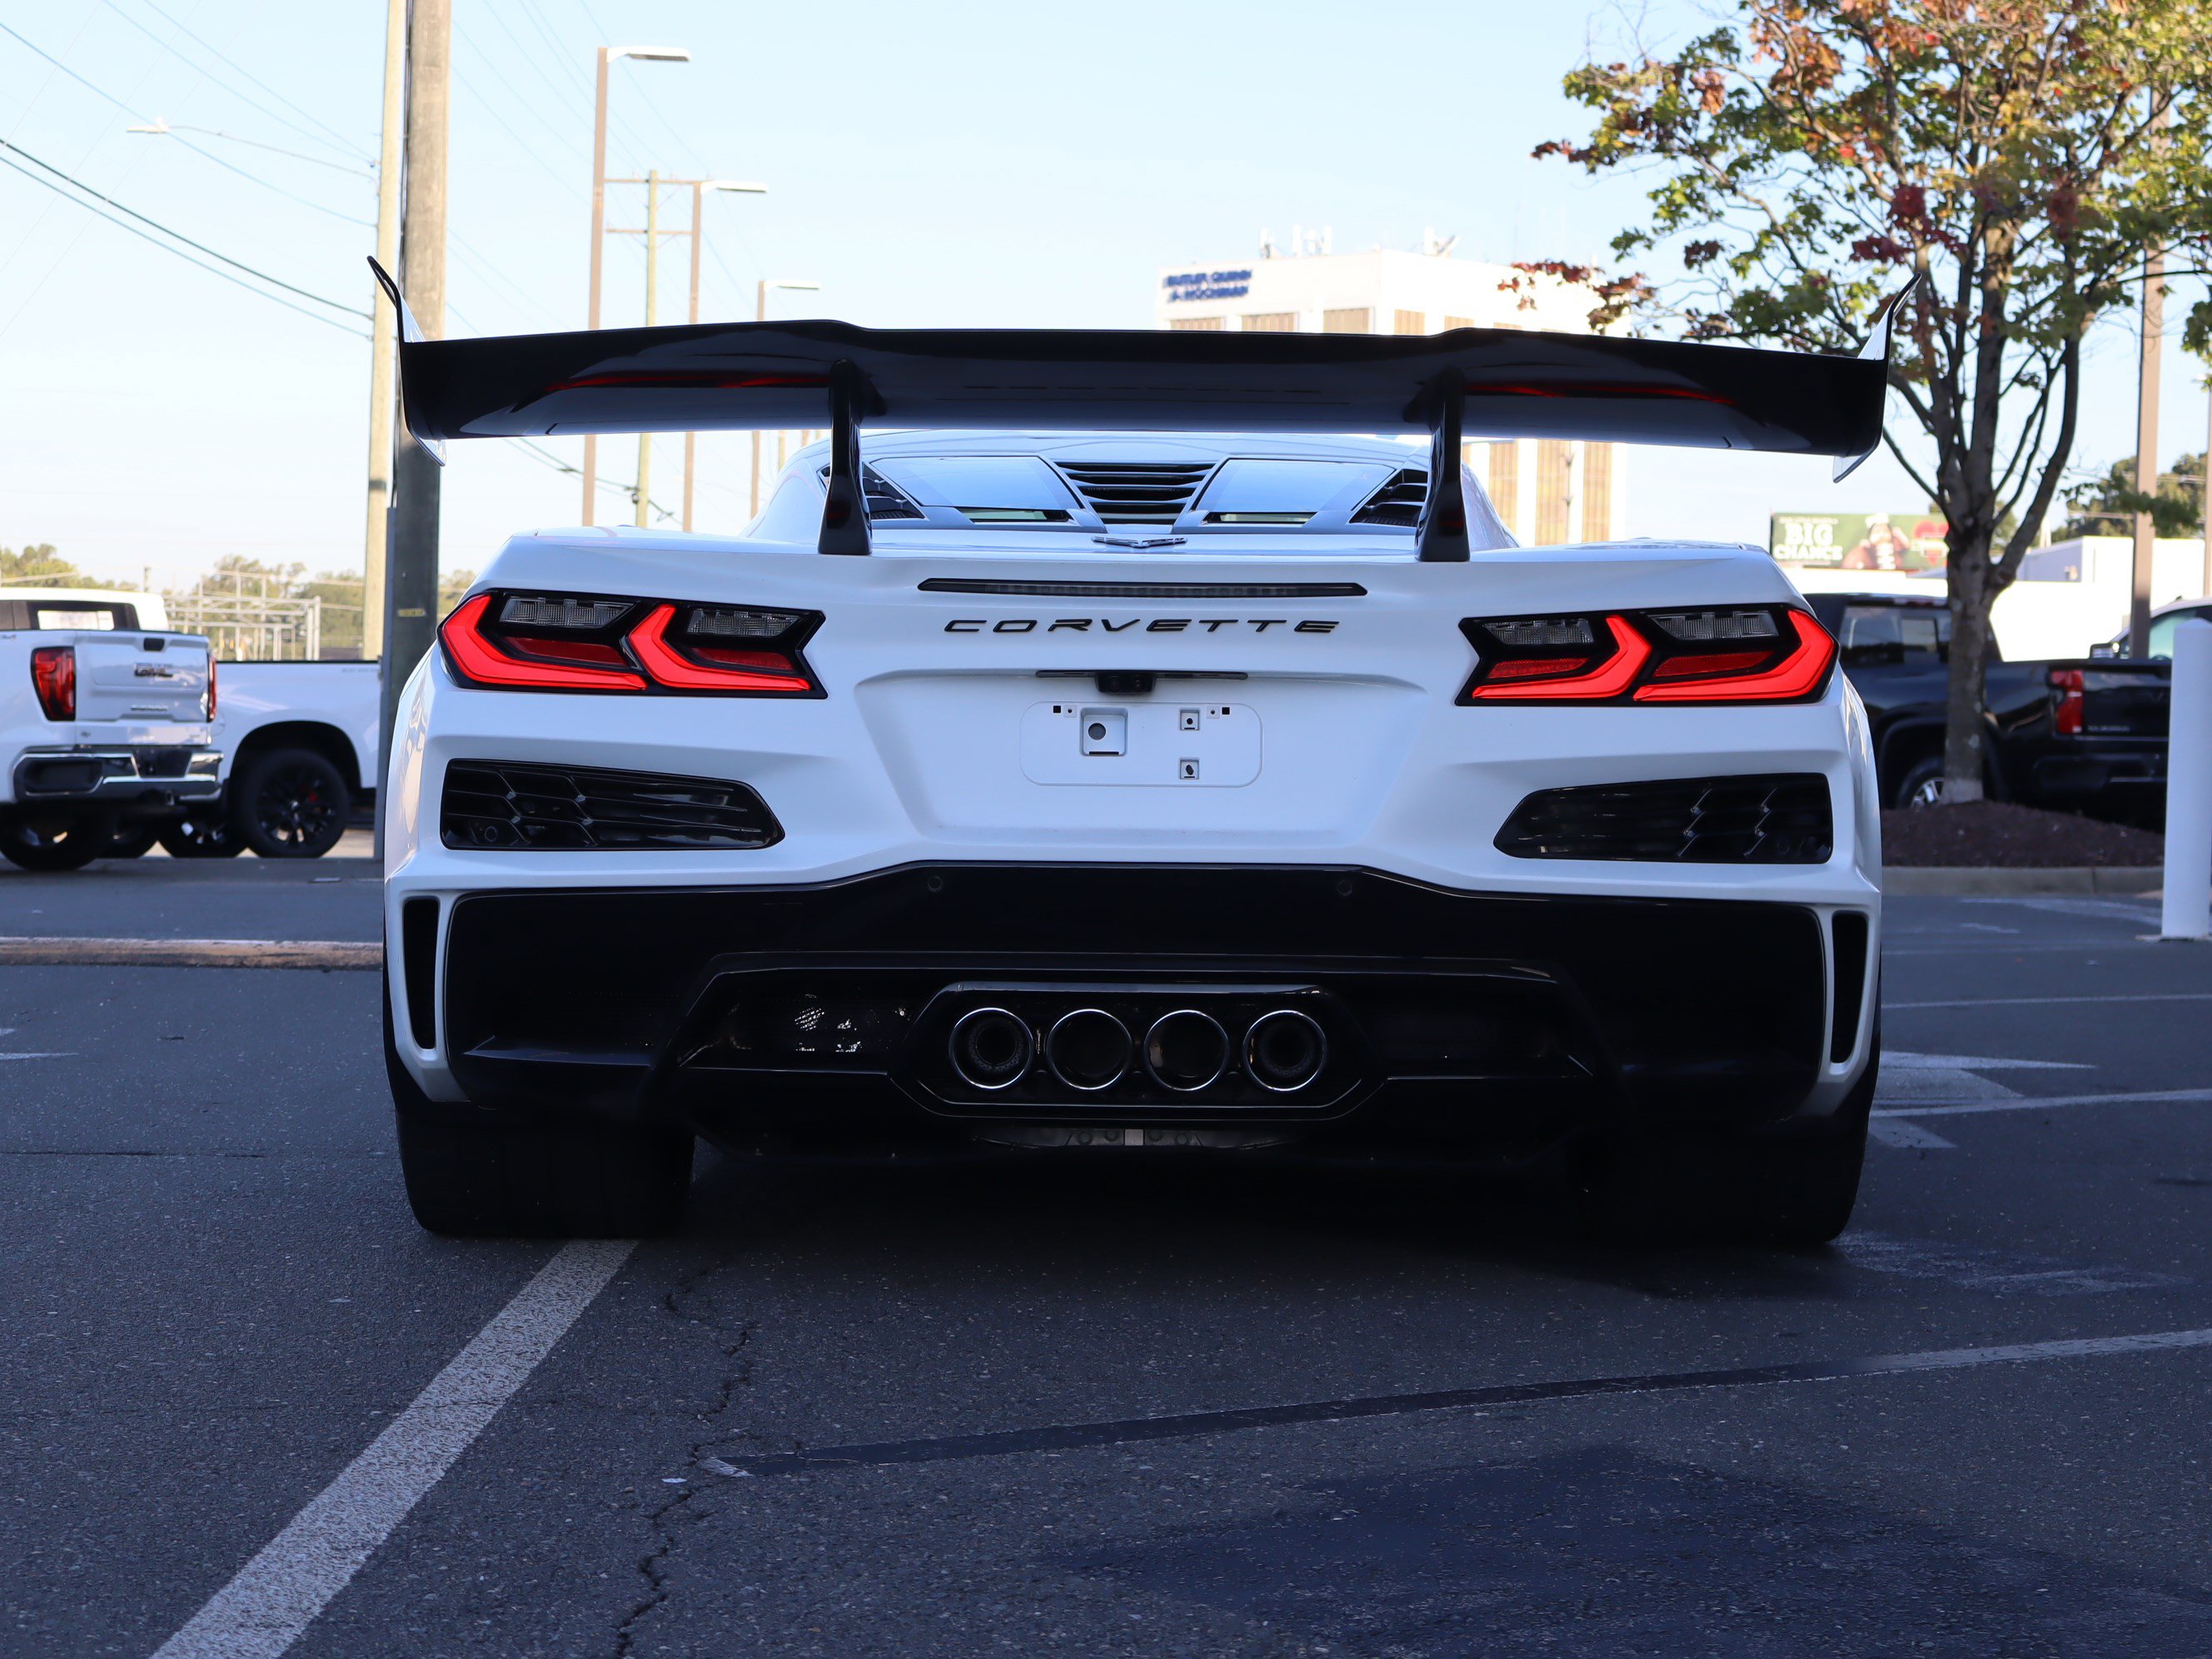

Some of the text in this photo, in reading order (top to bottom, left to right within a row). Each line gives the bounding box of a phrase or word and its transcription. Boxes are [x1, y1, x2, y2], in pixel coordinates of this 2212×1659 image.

[1785, 523, 1834, 546] BIG
[1774, 545, 1843, 560] CHANCE
[944, 618, 1340, 634] CORVETTE
